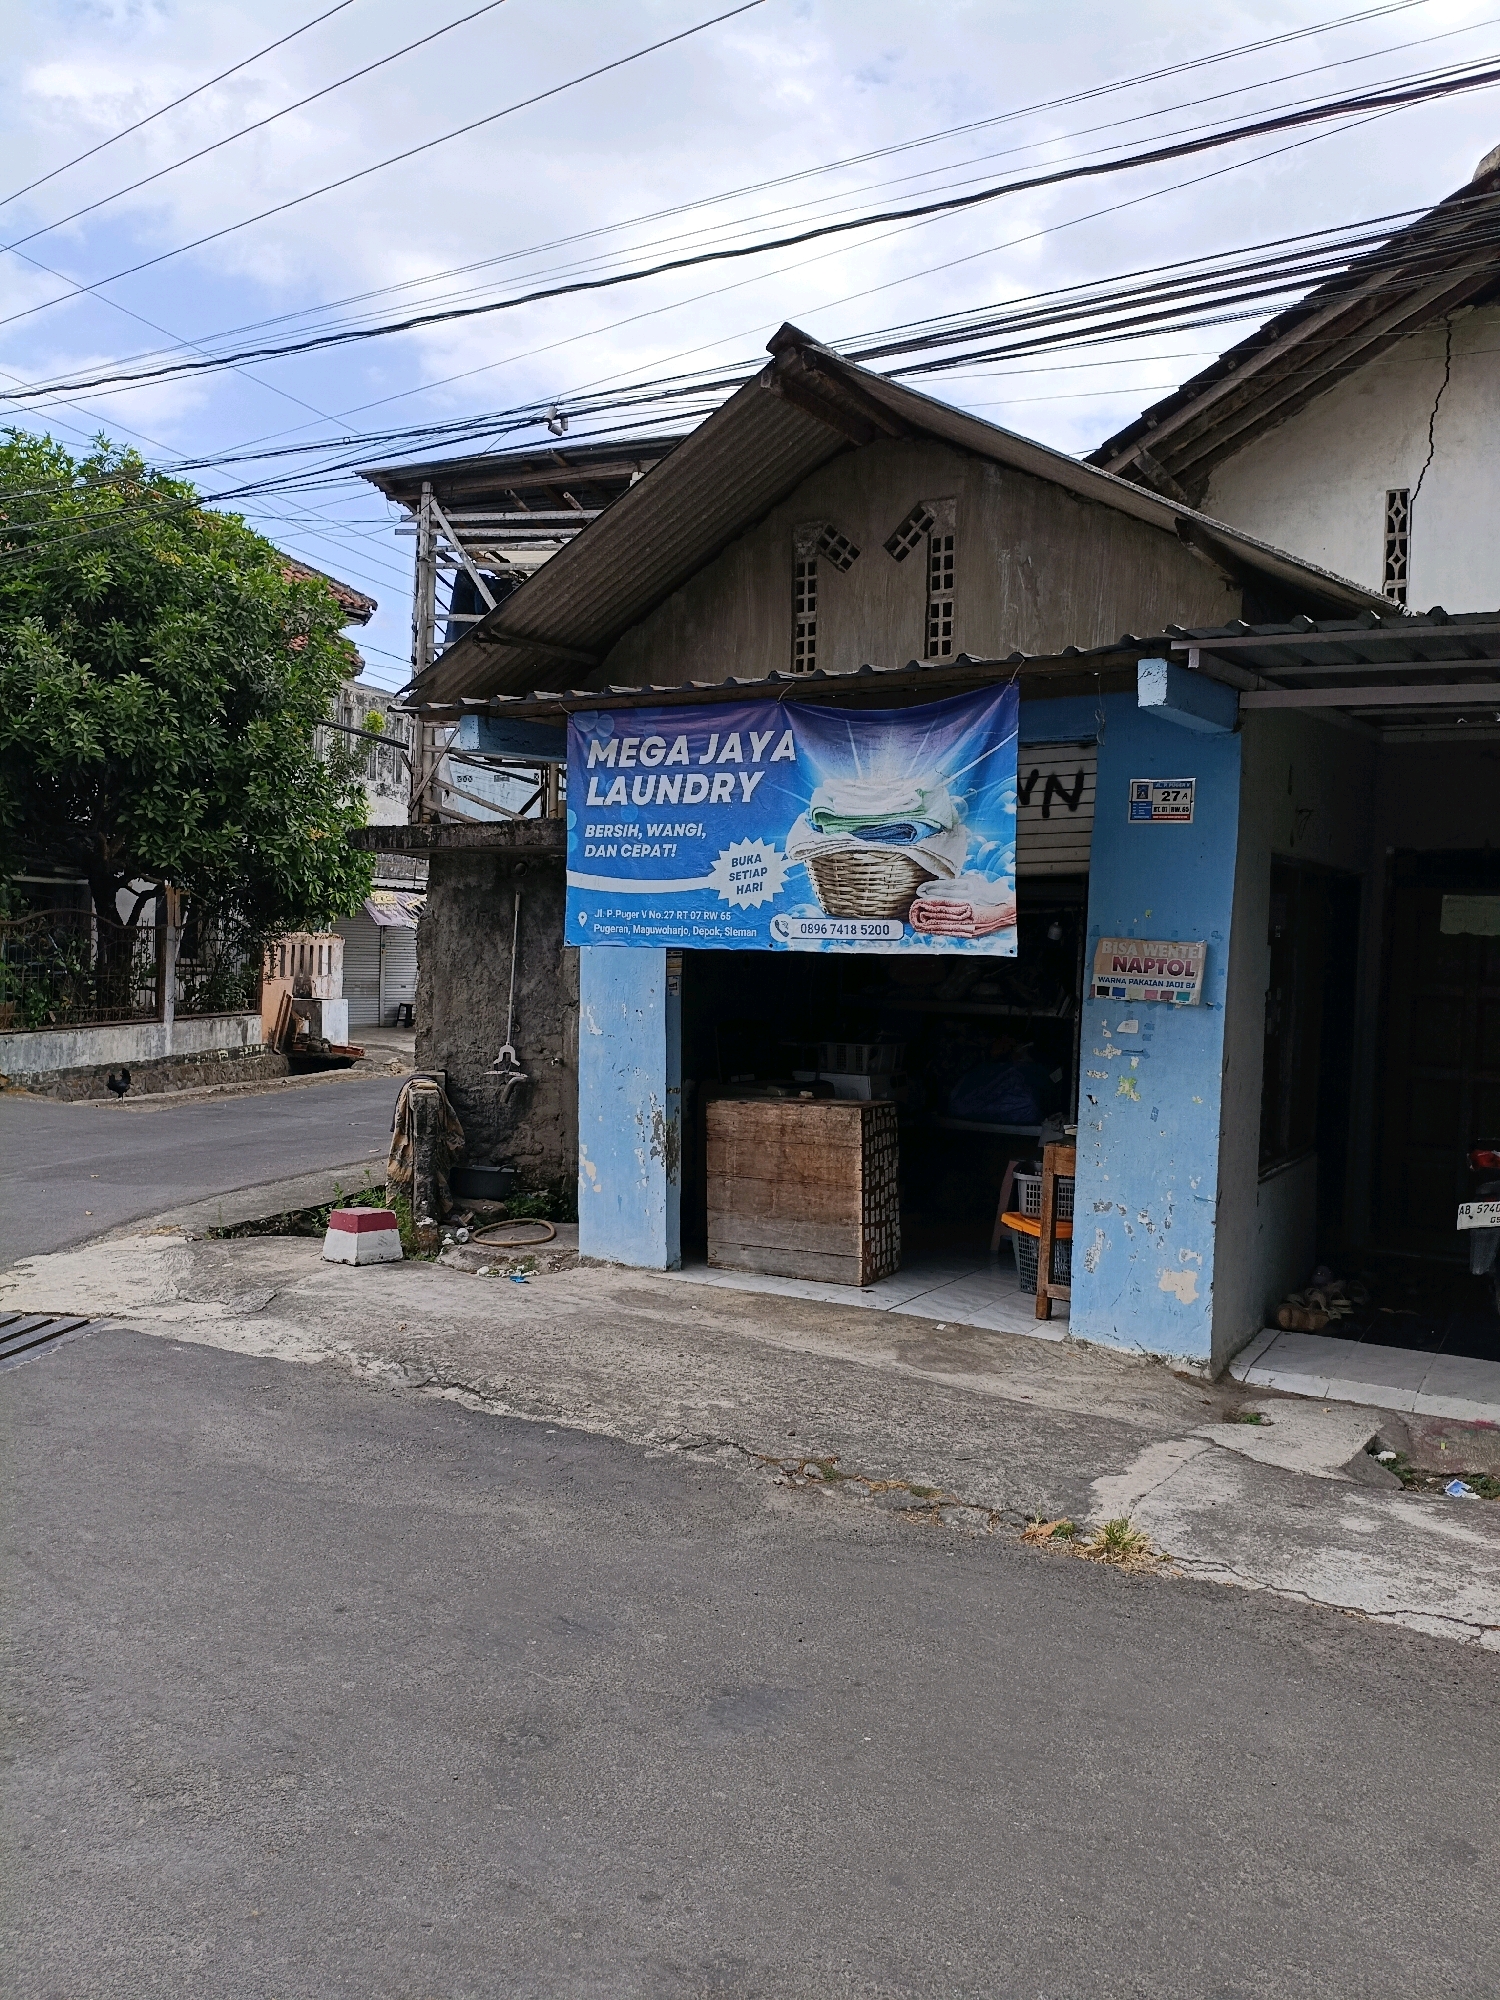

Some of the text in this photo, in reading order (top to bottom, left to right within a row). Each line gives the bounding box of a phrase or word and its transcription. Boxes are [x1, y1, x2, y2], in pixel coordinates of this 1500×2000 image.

[587, 729, 796, 769] MEGA JAYA
[586, 771, 766, 806] LAUNDRY
[1161, 790, 1188, 802] 27 A
[584, 823, 707, 840] BERSIH, WANGI,
[584, 843, 678, 858] DAN CEPAT!
[731, 853, 762, 868] BUKA
[728, 867, 768, 882] SETIAP
[736, 881, 764, 895] HARI
[594, 909, 605, 919] Jl.
[641, 910, 647, 919] V
[649, 910, 675, 920] No.27
[676, 910, 688, 920] RT
[690, 911, 701, 920] 07
[703, 911, 718, 921] RW
[720, 911, 732, 921] 65
[593, 924, 757, 938] Pugeran, Maguwoharjo, Depok, Sleman
[800, 923, 890, 936] 0896 7418 5200
[1101, 941, 1138, 956] BISA
[1112, 956, 1196, 978] NAPTOL
[1098, 976, 1127, 985] WARNA
[1128, 978, 1164, 988] PAKAIAN
[1165, 981, 1184, 989] JADI
[1458, 1204, 1471, 1215] AB
